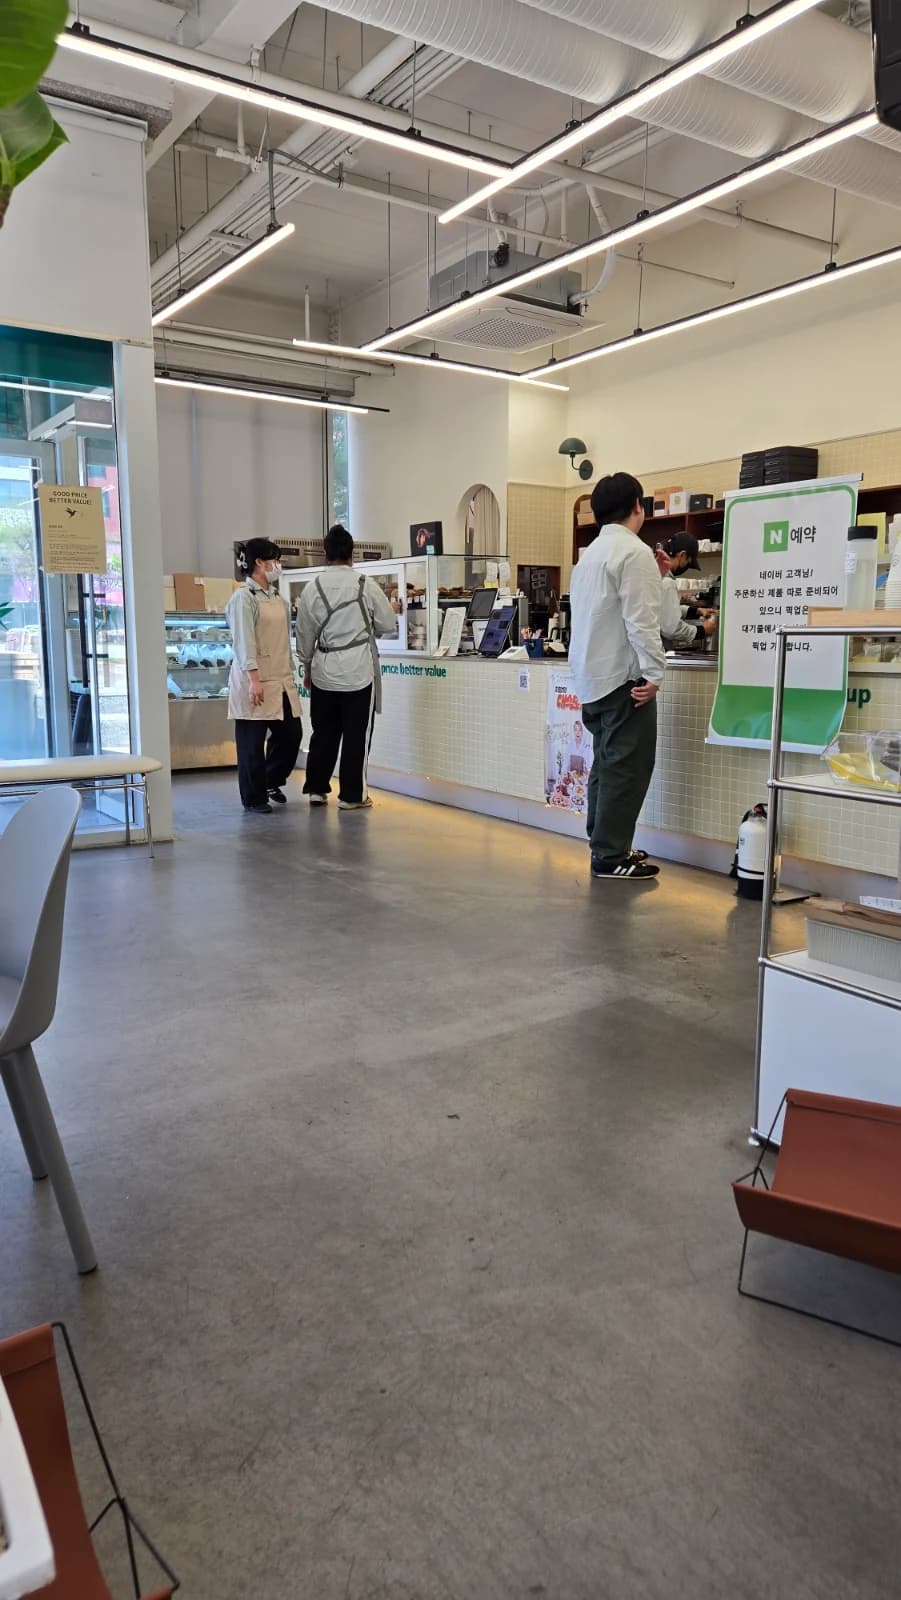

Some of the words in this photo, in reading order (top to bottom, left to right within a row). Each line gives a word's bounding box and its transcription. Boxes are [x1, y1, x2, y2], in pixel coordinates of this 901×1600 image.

[769, 529, 783, 545] N
[790, 525, 816, 544] 예약
[759, 569, 783, 580] 네이버
[785, 568, 814, 579] 고객님!
[734, 588, 765, 599] 주문하신
[767, 588, 783, 598] 제품
[786, 587, 803, 597] 따로
[806, 585, 839, 597] 준비되어
[759, 606, 782, 616] 있으니
[785, 605, 809, 616] 픽업은
[752, 641, 767, 651] 픽업
[400, 663, 423, 676] better
[425, 664, 447, 677] value
[847, 688, 871, 708] up
